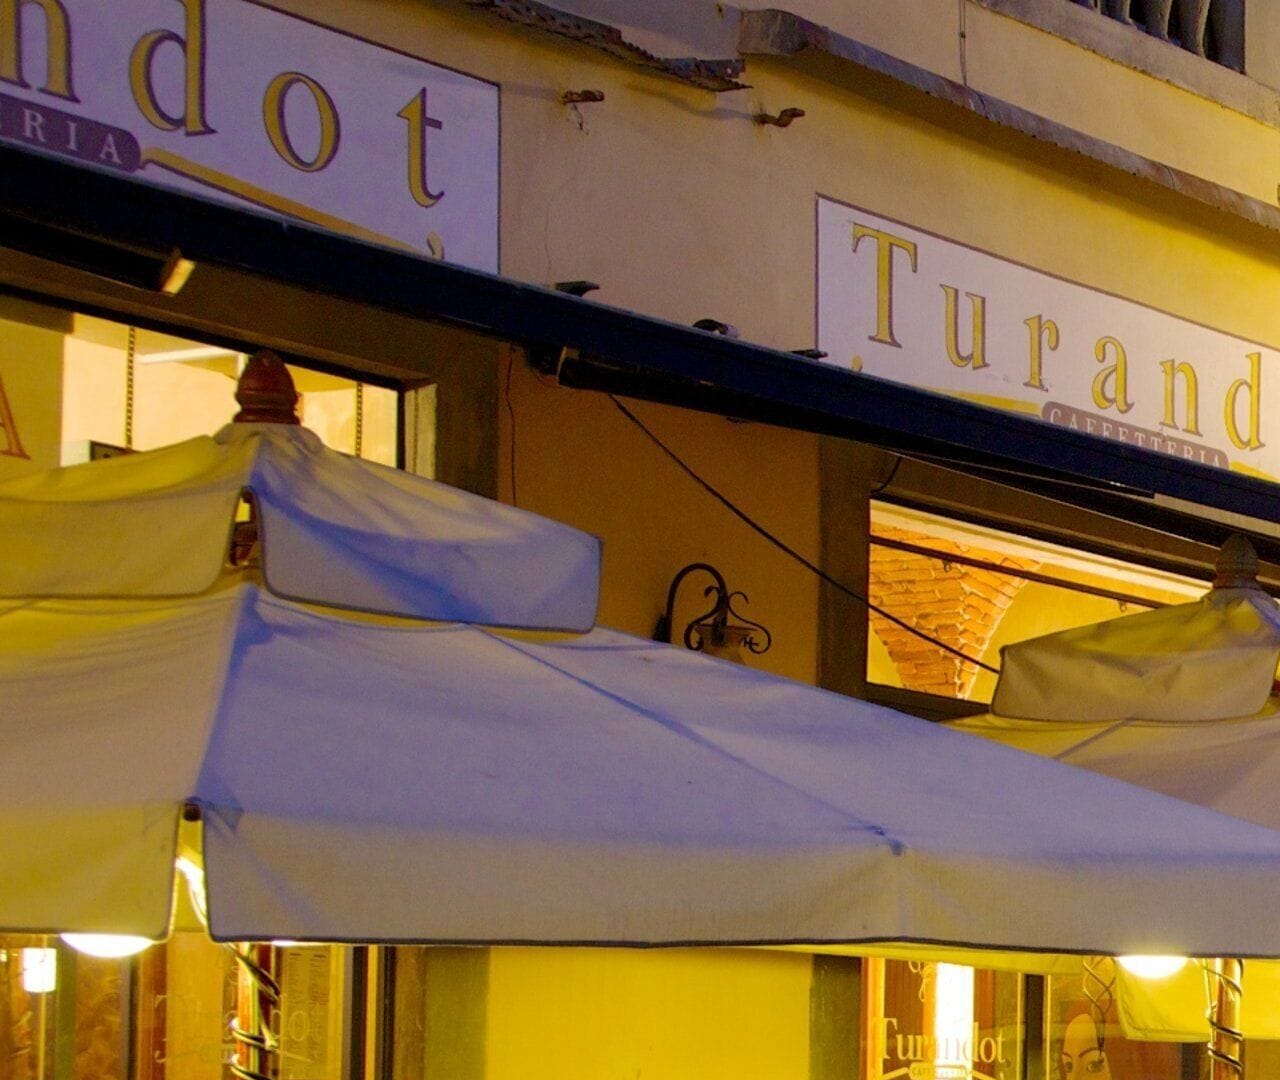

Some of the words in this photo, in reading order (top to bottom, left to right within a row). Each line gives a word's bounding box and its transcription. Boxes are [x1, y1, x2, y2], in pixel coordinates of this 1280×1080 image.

[22, 108, 123, 165] RIA
[1050, 408, 1221, 467] CAFFETTERIA
[874, 1017, 1006, 1063] Turandot
